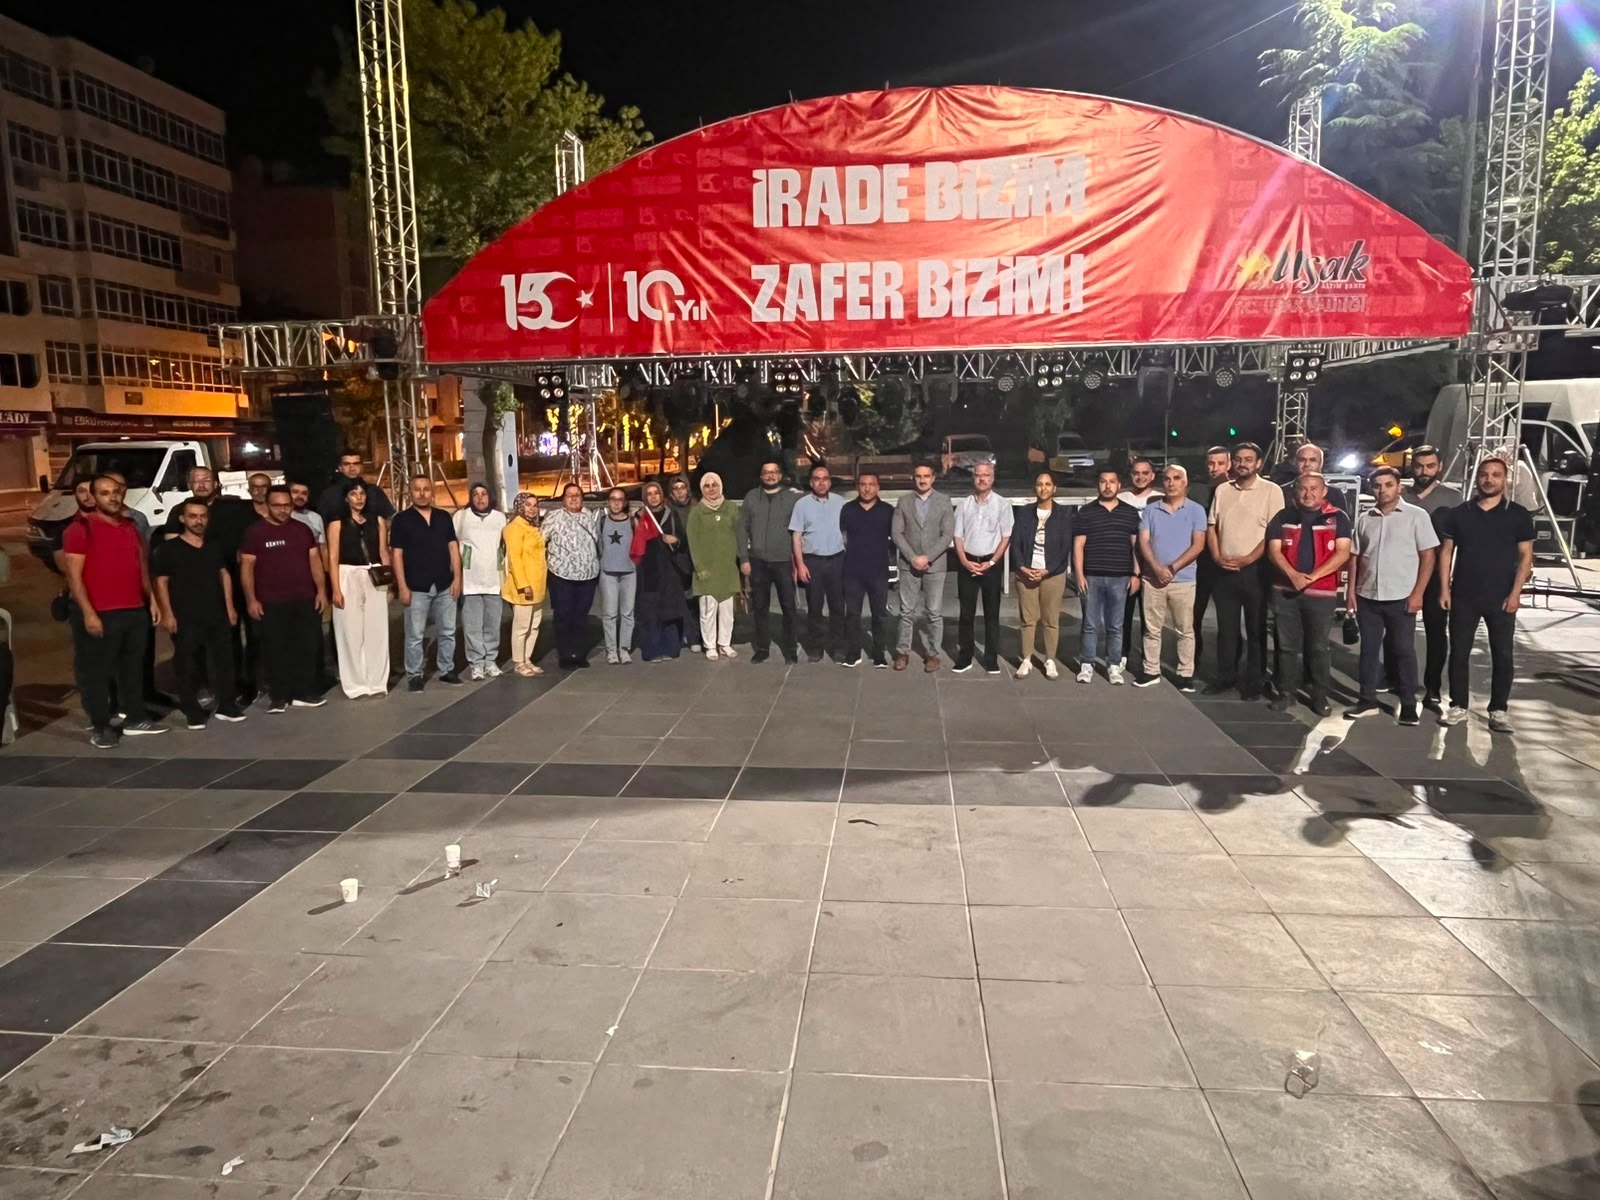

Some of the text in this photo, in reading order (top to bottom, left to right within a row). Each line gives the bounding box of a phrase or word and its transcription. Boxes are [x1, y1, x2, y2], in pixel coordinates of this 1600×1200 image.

[752, 154, 1086, 228] İRADE BİZİM
[751, 254, 1085, 323] ZAFER BİZİM!
